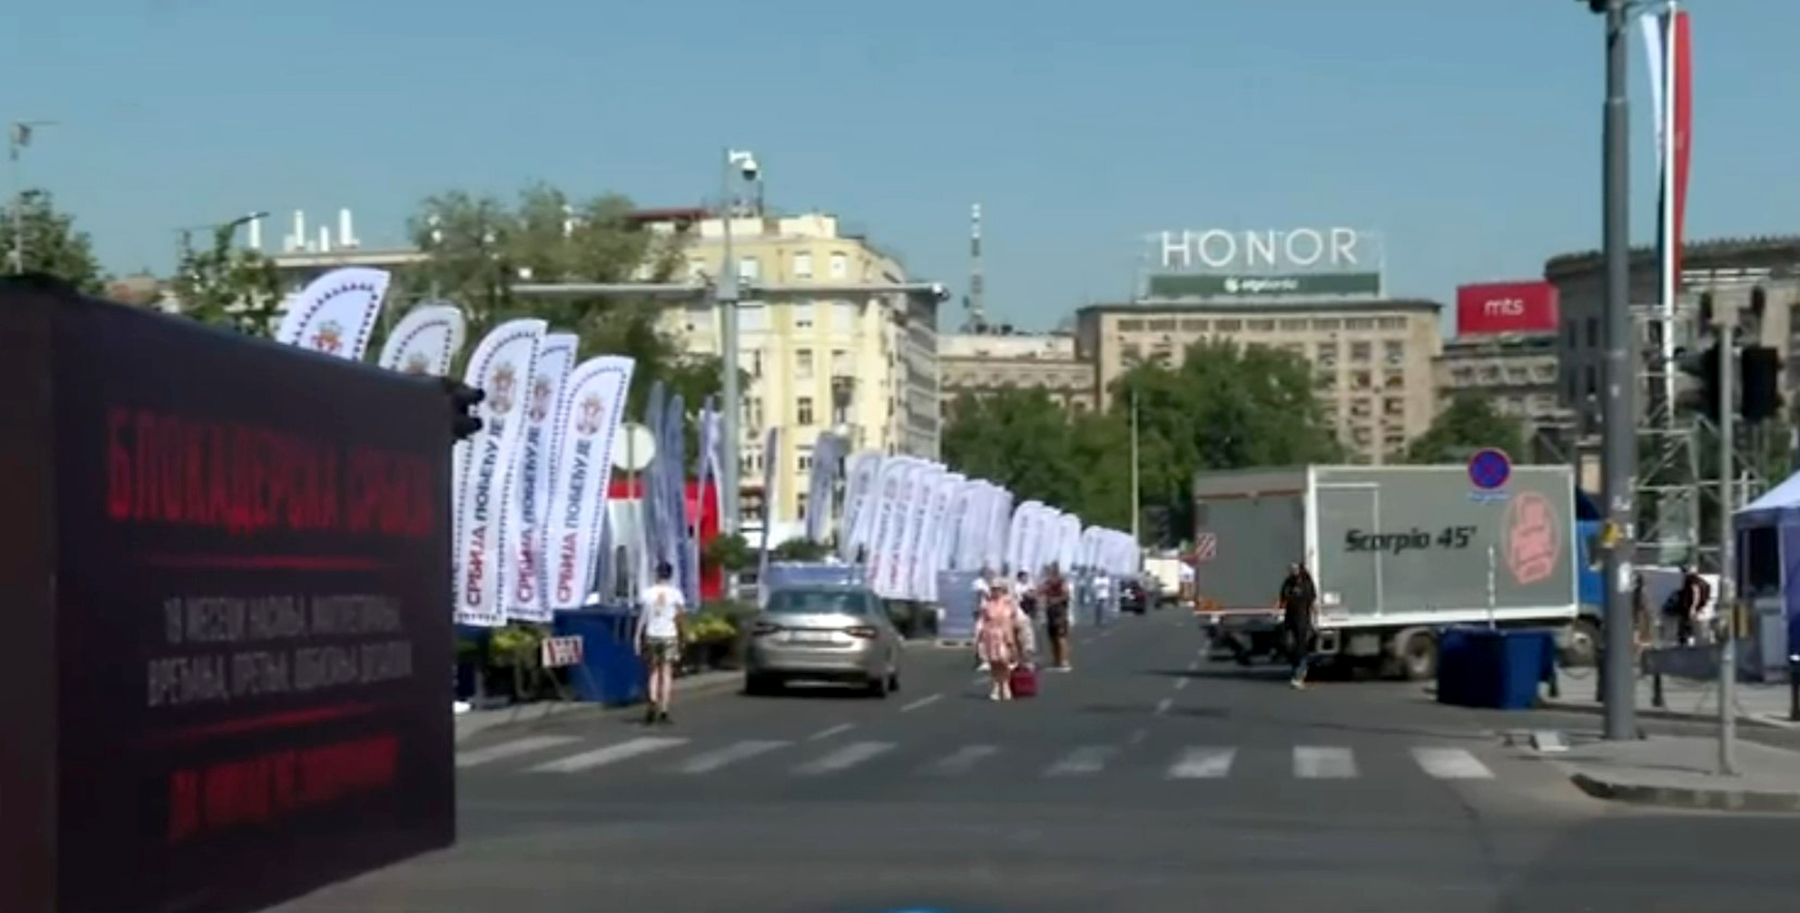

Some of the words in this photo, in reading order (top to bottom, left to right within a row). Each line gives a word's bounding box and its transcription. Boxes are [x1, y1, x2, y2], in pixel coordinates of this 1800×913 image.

[1161, 228, 1357, 267] HONOR
[1484, 298, 1524, 316] mts
[1344, 528, 1430, 555] Scorpio
[467, 526, 486, 606] СРБИЈА
[557, 532, 577, 603] СРБИЈА
